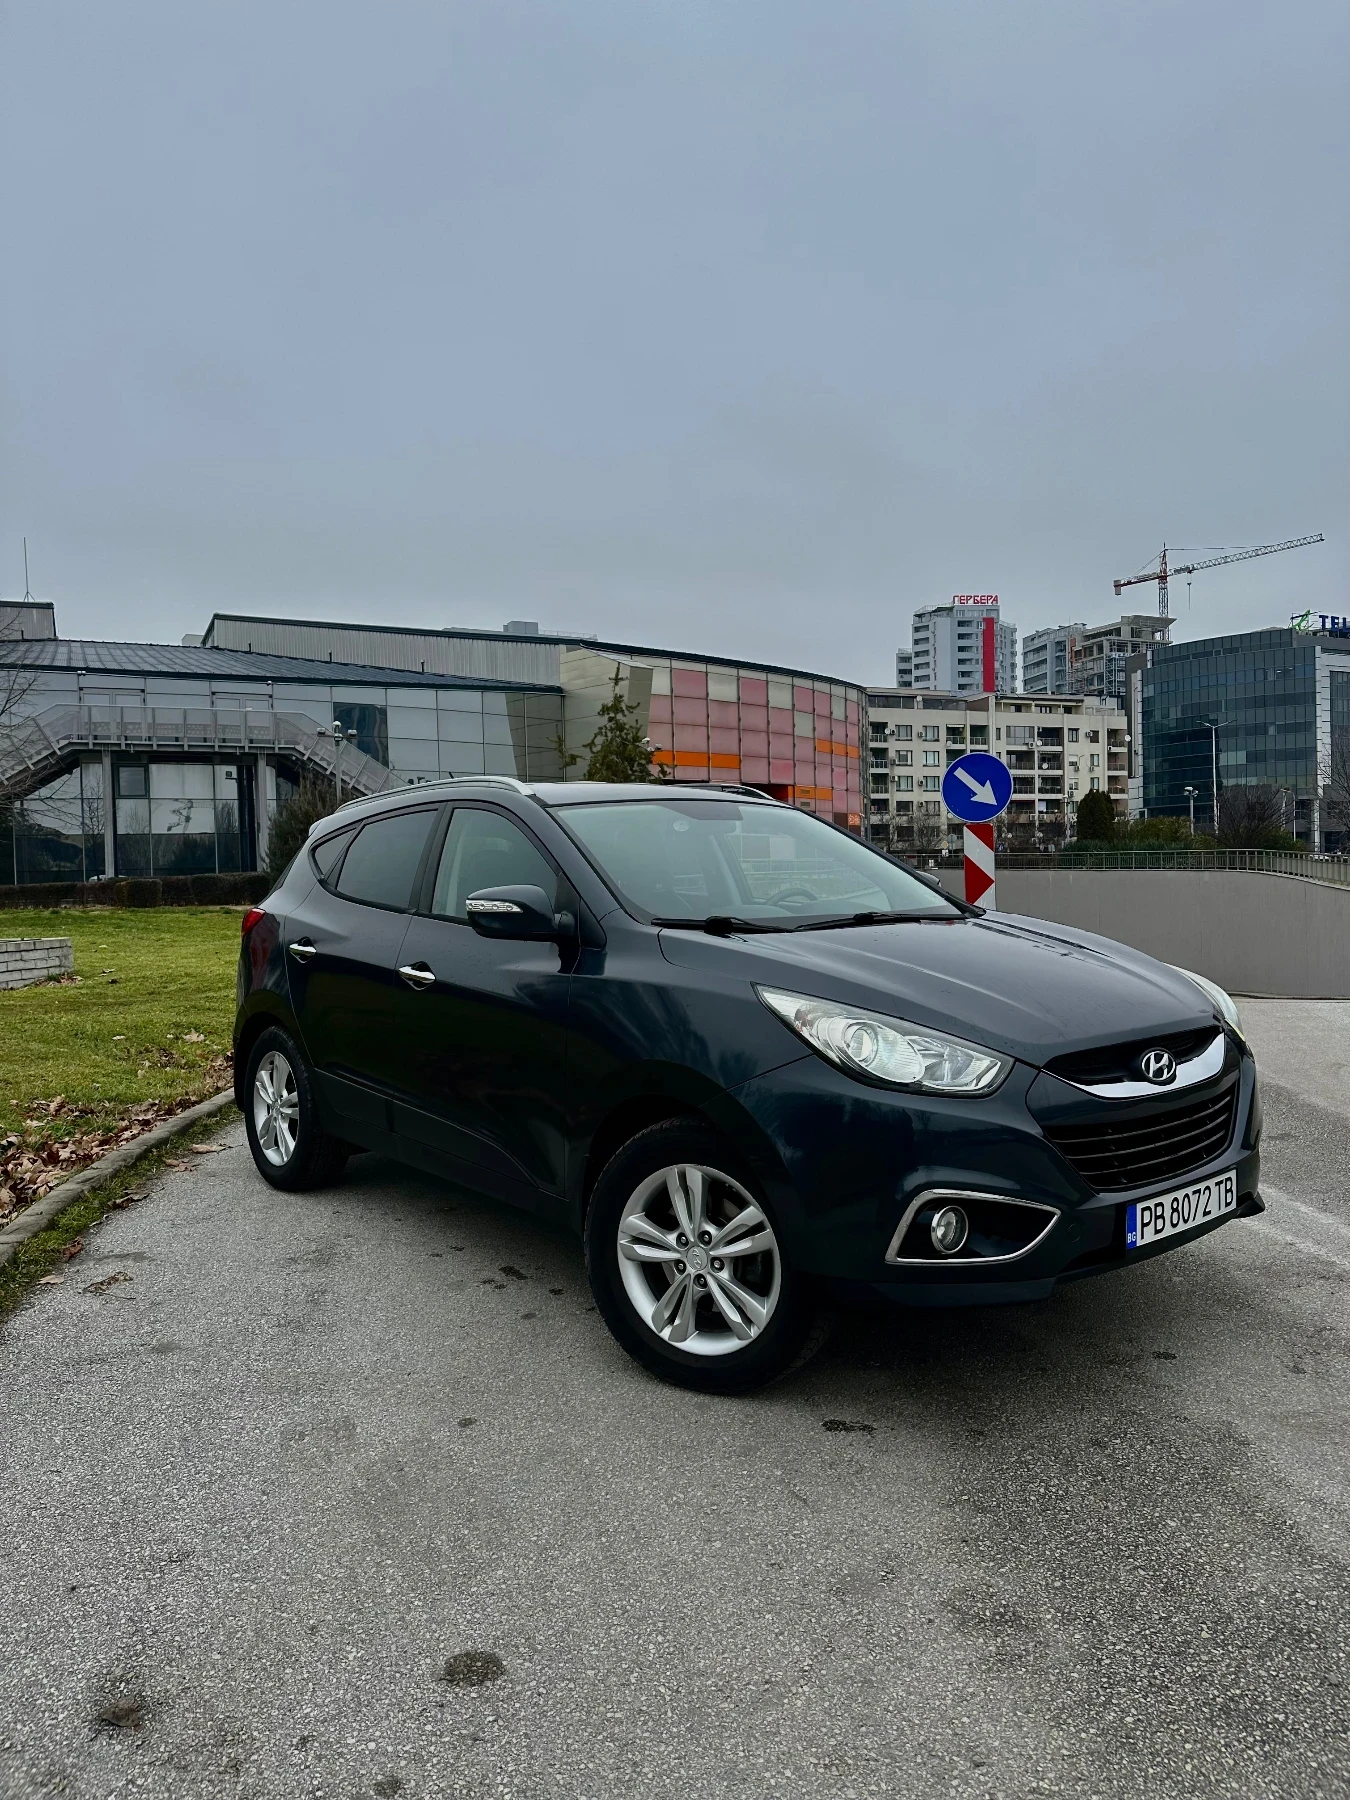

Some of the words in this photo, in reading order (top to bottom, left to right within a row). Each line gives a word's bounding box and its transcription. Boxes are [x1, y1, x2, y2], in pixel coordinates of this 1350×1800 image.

[953, 594, 999, 605] ГЕРБЕРА
[1140, 1201, 1165, 1240] PB
[1170, 1186, 1212, 1228] 8072
[1215, 1176, 1234, 1211] TB
[1127, 1232, 1137, 1243] BG
